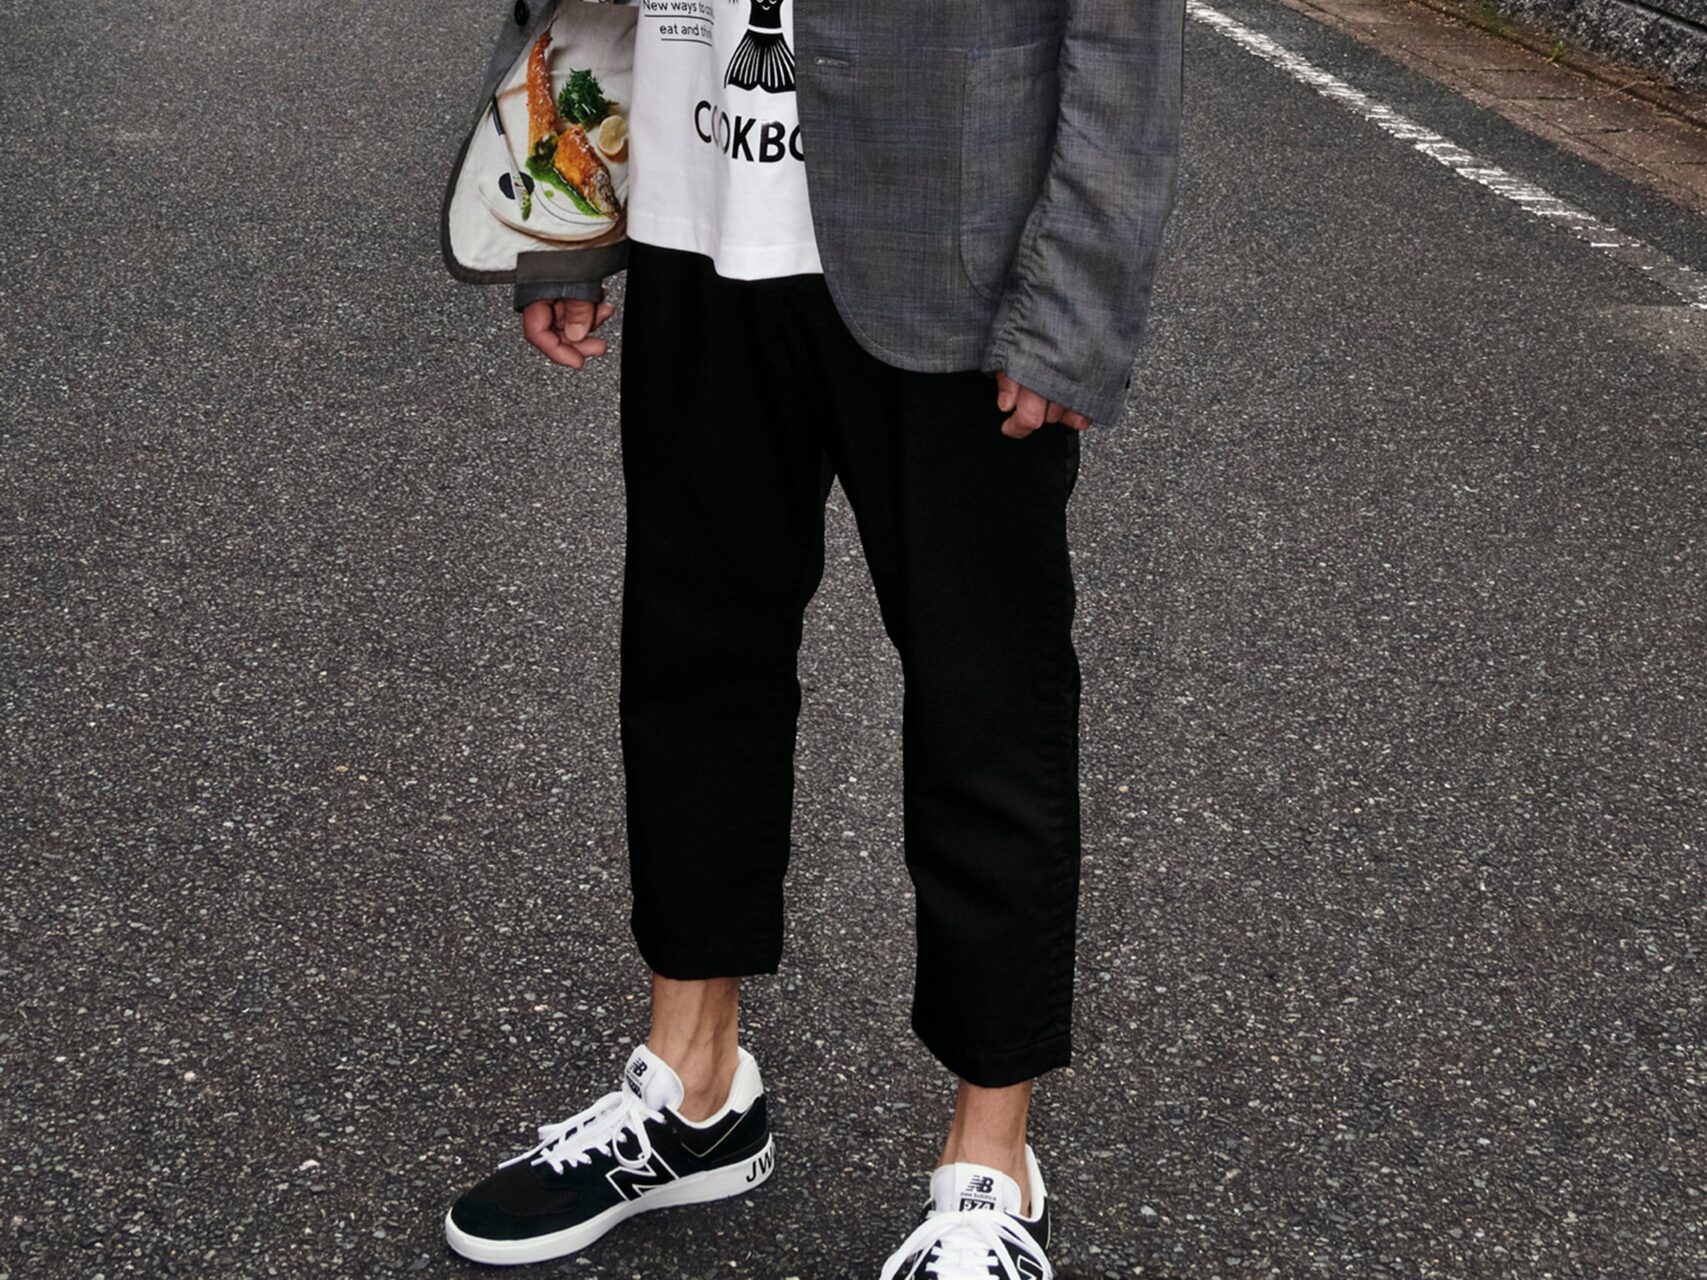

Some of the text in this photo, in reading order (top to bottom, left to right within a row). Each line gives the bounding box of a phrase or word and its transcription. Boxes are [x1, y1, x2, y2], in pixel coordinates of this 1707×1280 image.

[671, 2, 697, 14] ways
[659, 24, 678, 35] eat
[681, 24, 699, 36] and
